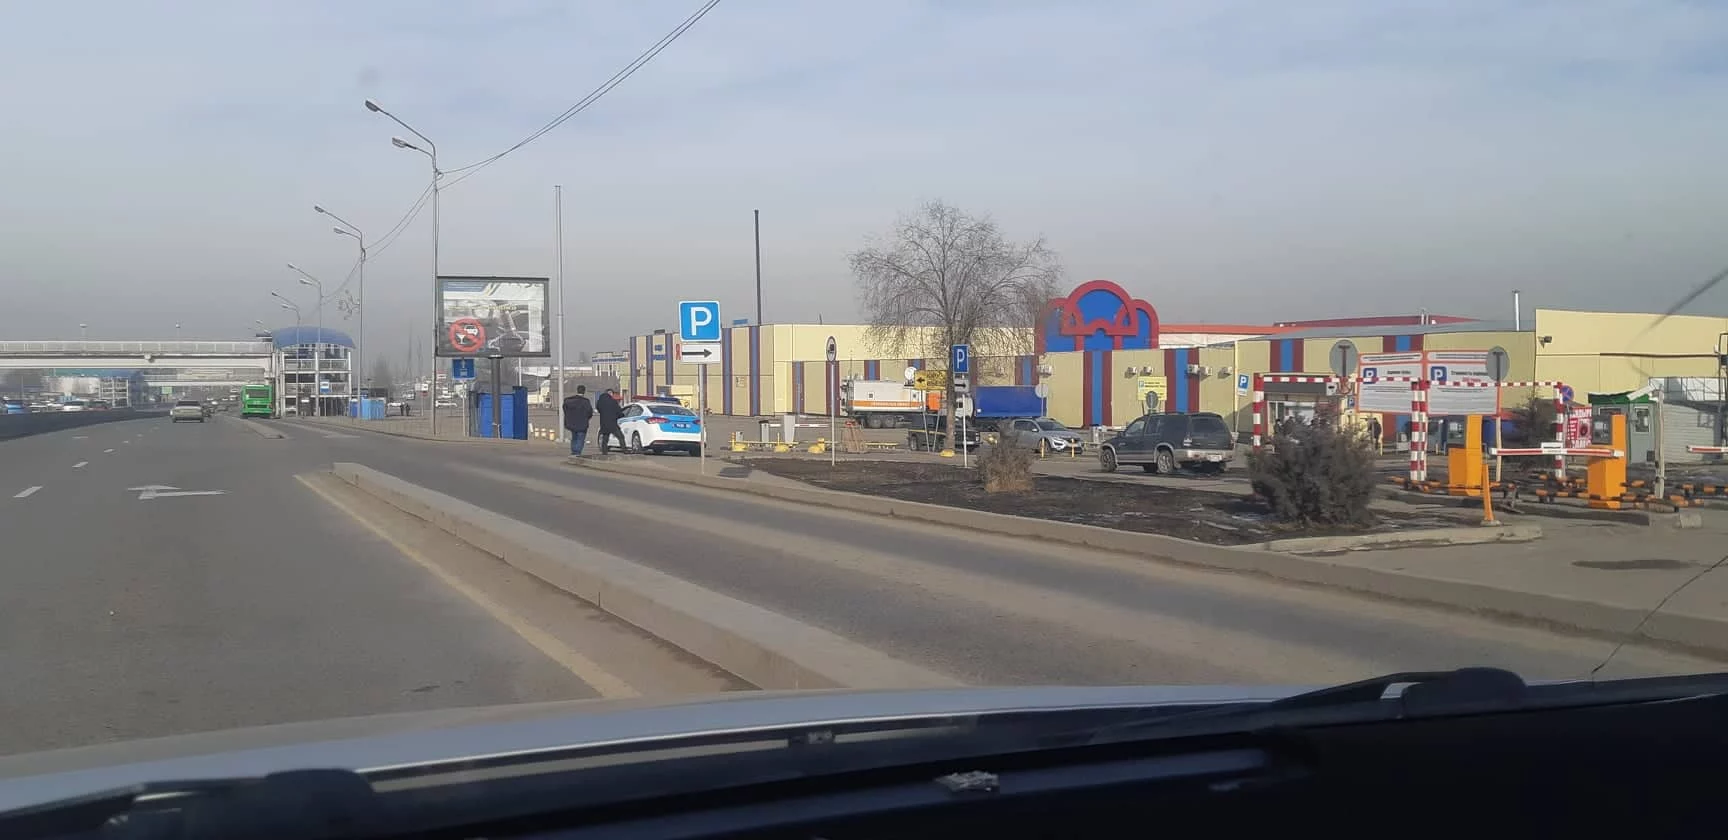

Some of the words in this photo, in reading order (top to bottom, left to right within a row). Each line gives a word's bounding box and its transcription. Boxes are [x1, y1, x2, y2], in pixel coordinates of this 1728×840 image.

[690, 306, 712, 336] P
[957, 348, 965, 369] P
[1240, 376, 1247, 386] P
[1434, 369, 1443, 381] P
